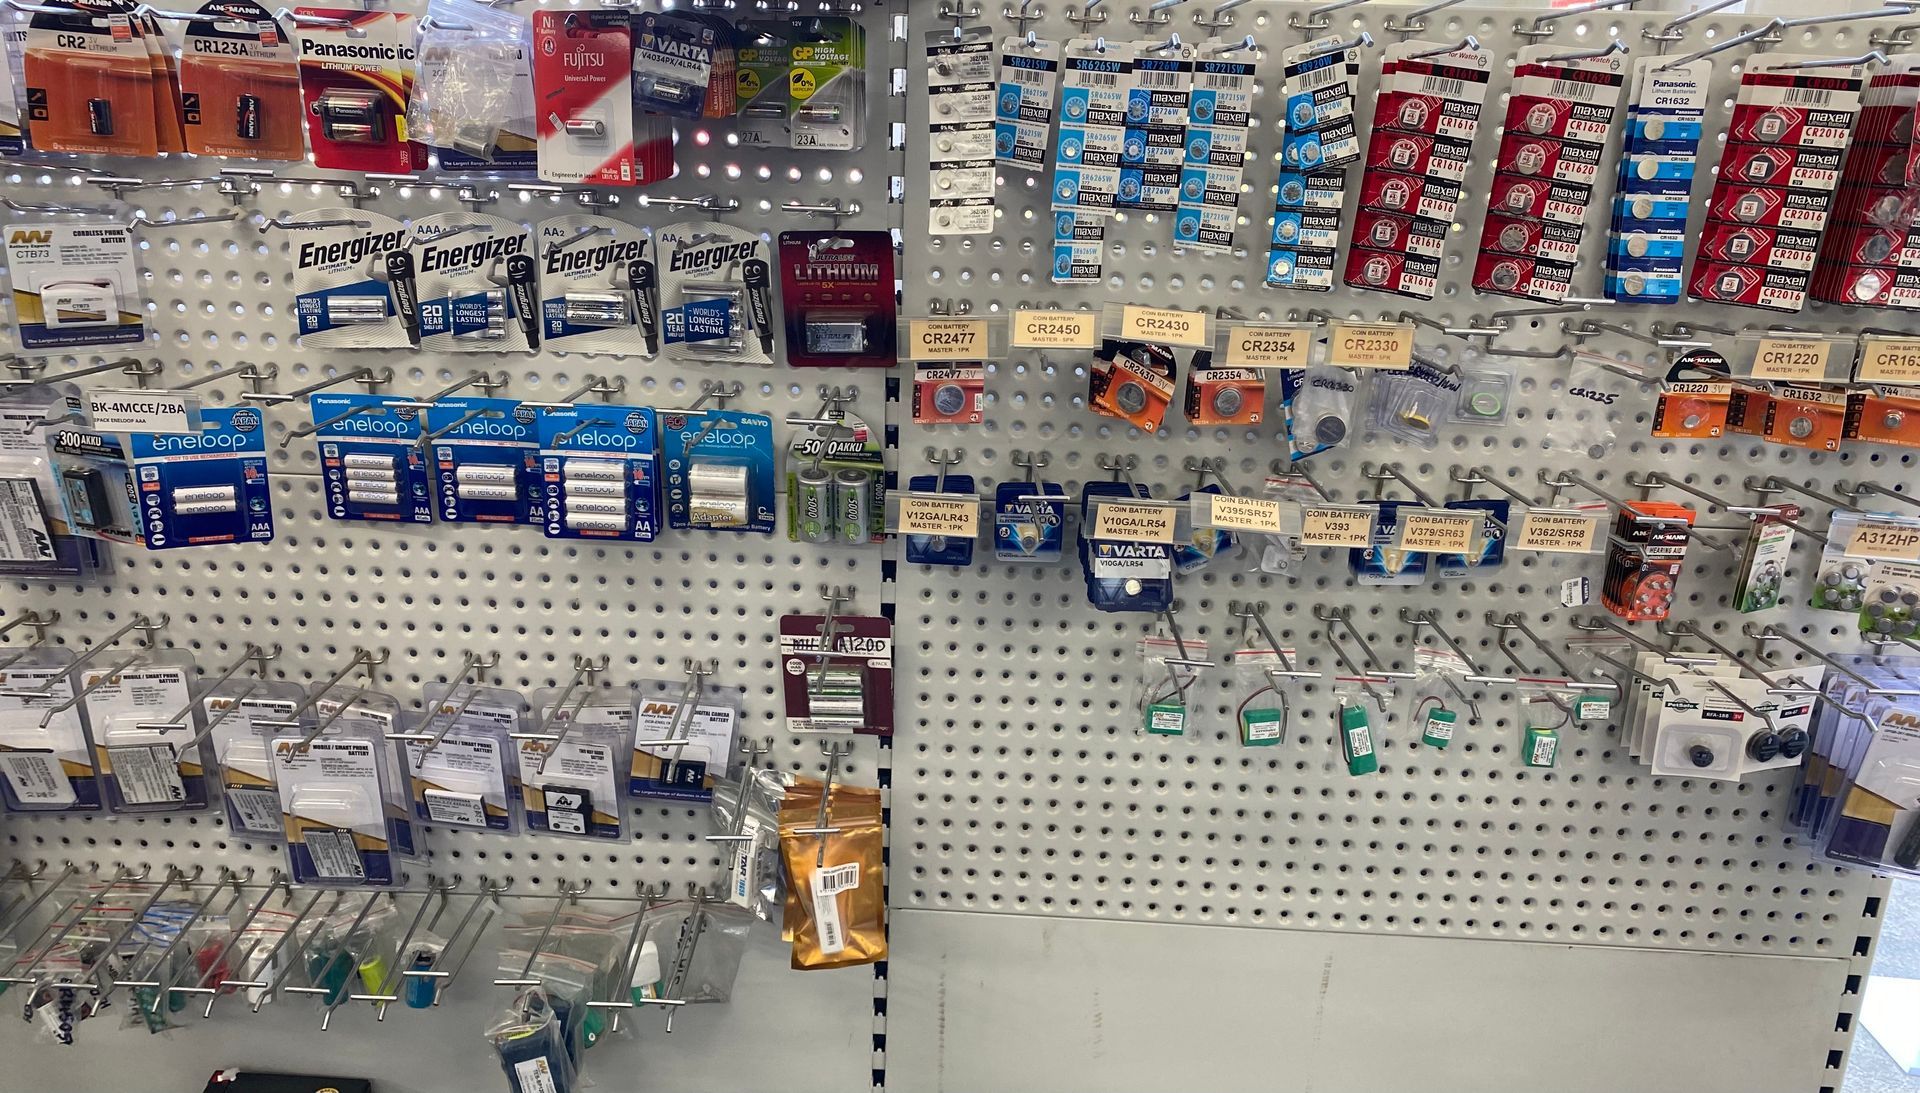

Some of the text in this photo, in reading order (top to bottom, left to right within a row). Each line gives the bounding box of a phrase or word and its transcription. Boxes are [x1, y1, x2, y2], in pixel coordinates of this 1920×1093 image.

[57, 34, 86, 49] CR2
[194, 39, 248, 56] CR123A
[302, 38, 395, 60] Panasonic
[657, 41, 710, 63] VARTA
[792, 46, 813, 61] GP
[564, 53, 604, 70] FUJITSU
[641, 54, 702, 72] V4034PX/4LR44
[815, 53, 850, 61] VOLTAGE
[321, 62, 382, 72] LITHIUM POWER
[1011, 58, 1048, 70] SR621SW
[1076, 59, 1121, 72] SR626SW
[1205, 63, 1245, 74] SR721SW
[800, 79, 814, 87] 0%
[1653, 80, 1697, 88] Panasonic
[1090, 91, 1122, 100] SR626SW
[1152, 93, 1186, 103] maxell
[1656, 97, 1690, 105] CR1632
[335, 107, 364, 115] Panasonic
[1020, 107, 1048, 118] maxell
[1088, 111, 1123, 122] maxell
[1151, 107, 1179, 115] SR726W
[1441, 117, 1475, 131] CR1616
[1569, 120, 1606, 134] CR1620
[742, 132, 760, 143] 27A
[1148, 134, 1182, 144] maxell
[1805, 127, 1845, 139] CR2016
[797, 134, 817, 146] 23A
[1084, 152, 1118, 163] maxell
[1431, 158, 1464, 173] CR1616
[1558, 162, 1594, 175] CR1620
[1794, 168, 1834, 181] CR2016
[1079, 193, 1113, 204] maxell
[1421, 199, 1454, 213] CR1616
[1548, 202, 1583, 216] CR1620
[1784, 209, 1823, 222] CR2016
[1074, 227, 1101, 236] maxell
[1410, 236, 1441, 250] CR1616
[1541, 240, 1576, 254] CR1620
[16, 250, 50, 259] CTB73
[299, 230, 406, 269] Energizer
[421, 234, 528, 273] Energizer
[546, 239, 648, 272] Energizer
[1774, 249, 1812, 262] CR2016
[669, 240, 759, 272] Energizer
[794, 264, 879, 281] LITHIUM
[1072, 265, 1099, 275] maxell
[1403, 274, 1434, 289] CR1616
[1533, 280, 1567, 294] CR1620
[1763, 288, 1801, 302] CR2016
[422, 305, 442, 317] 20
[455, 310, 486, 318] LONGEST
[306, 315, 318, 323] 20
[423, 316, 443, 325] YEAR
[456, 316, 486, 324] LASTING
[689, 316, 724, 326] LONGEST
[1135, 318, 1190, 331] CR2430
[689, 325, 725, 334] LASTING
[1027, 323, 1081, 335] CR2450
[922, 332, 976, 345] CR2477
[1241, 340, 1295, 353] CR2354
[1344, 338, 1399, 352] CR2330
[1763, 351, 1819, 365] CR1220
[1123, 359, 1156, 383] CR2430
[1206, 370, 1242, 380] CR2354
[1673, 384, 1708, 393] CR1220
[1783, 390, 1822, 401] CR1632
[91, 402, 186, 416] BK-4MCCE/2BA
[332, 417, 408, 437] eneloop
[741, 417, 768, 427] SANYO
[60, 431, 80, 447] 300
[81, 434, 102, 446] AKKU
[152, 431, 247, 450] eneloop
[465, 472, 505, 482] eneloop
[184, 491, 226, 500] eneloop
[467, 488, 507, 498] eneloop
[576, 504, 616, 512] eneloop
[808, 496, 818, 518] 5000
[1214, 496, 1277, 508] COIN BATTERY
[186, 505, 227, 513] eneloop
[414, 507, 430, 515] AAA
[530, 506, 544, 516] AA
[848, 498, 858, 520] 5000
[1219, 505, 1273, 519] V395/SR57
[1307, 510, 1371, 520] COIN BATTERY
[692, 512, 733, 524] Adapter
[906, 512, 969, 523] V12GA/LR43
[1102, 517, 1166, 528] V10GA/LR54
[1432, 516, 1470, 525] BATTERY
[1552, 517, 1587, 525] BATTERY
[251, 523, 270, 531] AAA
[635, 521, 651, 531] AA
[910, 522, 940, 530] MASTER
[1325, 522, 1350, 531] V393
[1304, 532, 1367, 542] MASTER 1PK
[1411, 527, 1465, 538] V379/SR63
[1530, 527, 1585, 538] V362/SR58
[1527, 538, 1583, 547] MASTER 1PK
[1856, 532, 1919, 546] A312HP
[1113, 545, 1165, 558] VARTA
